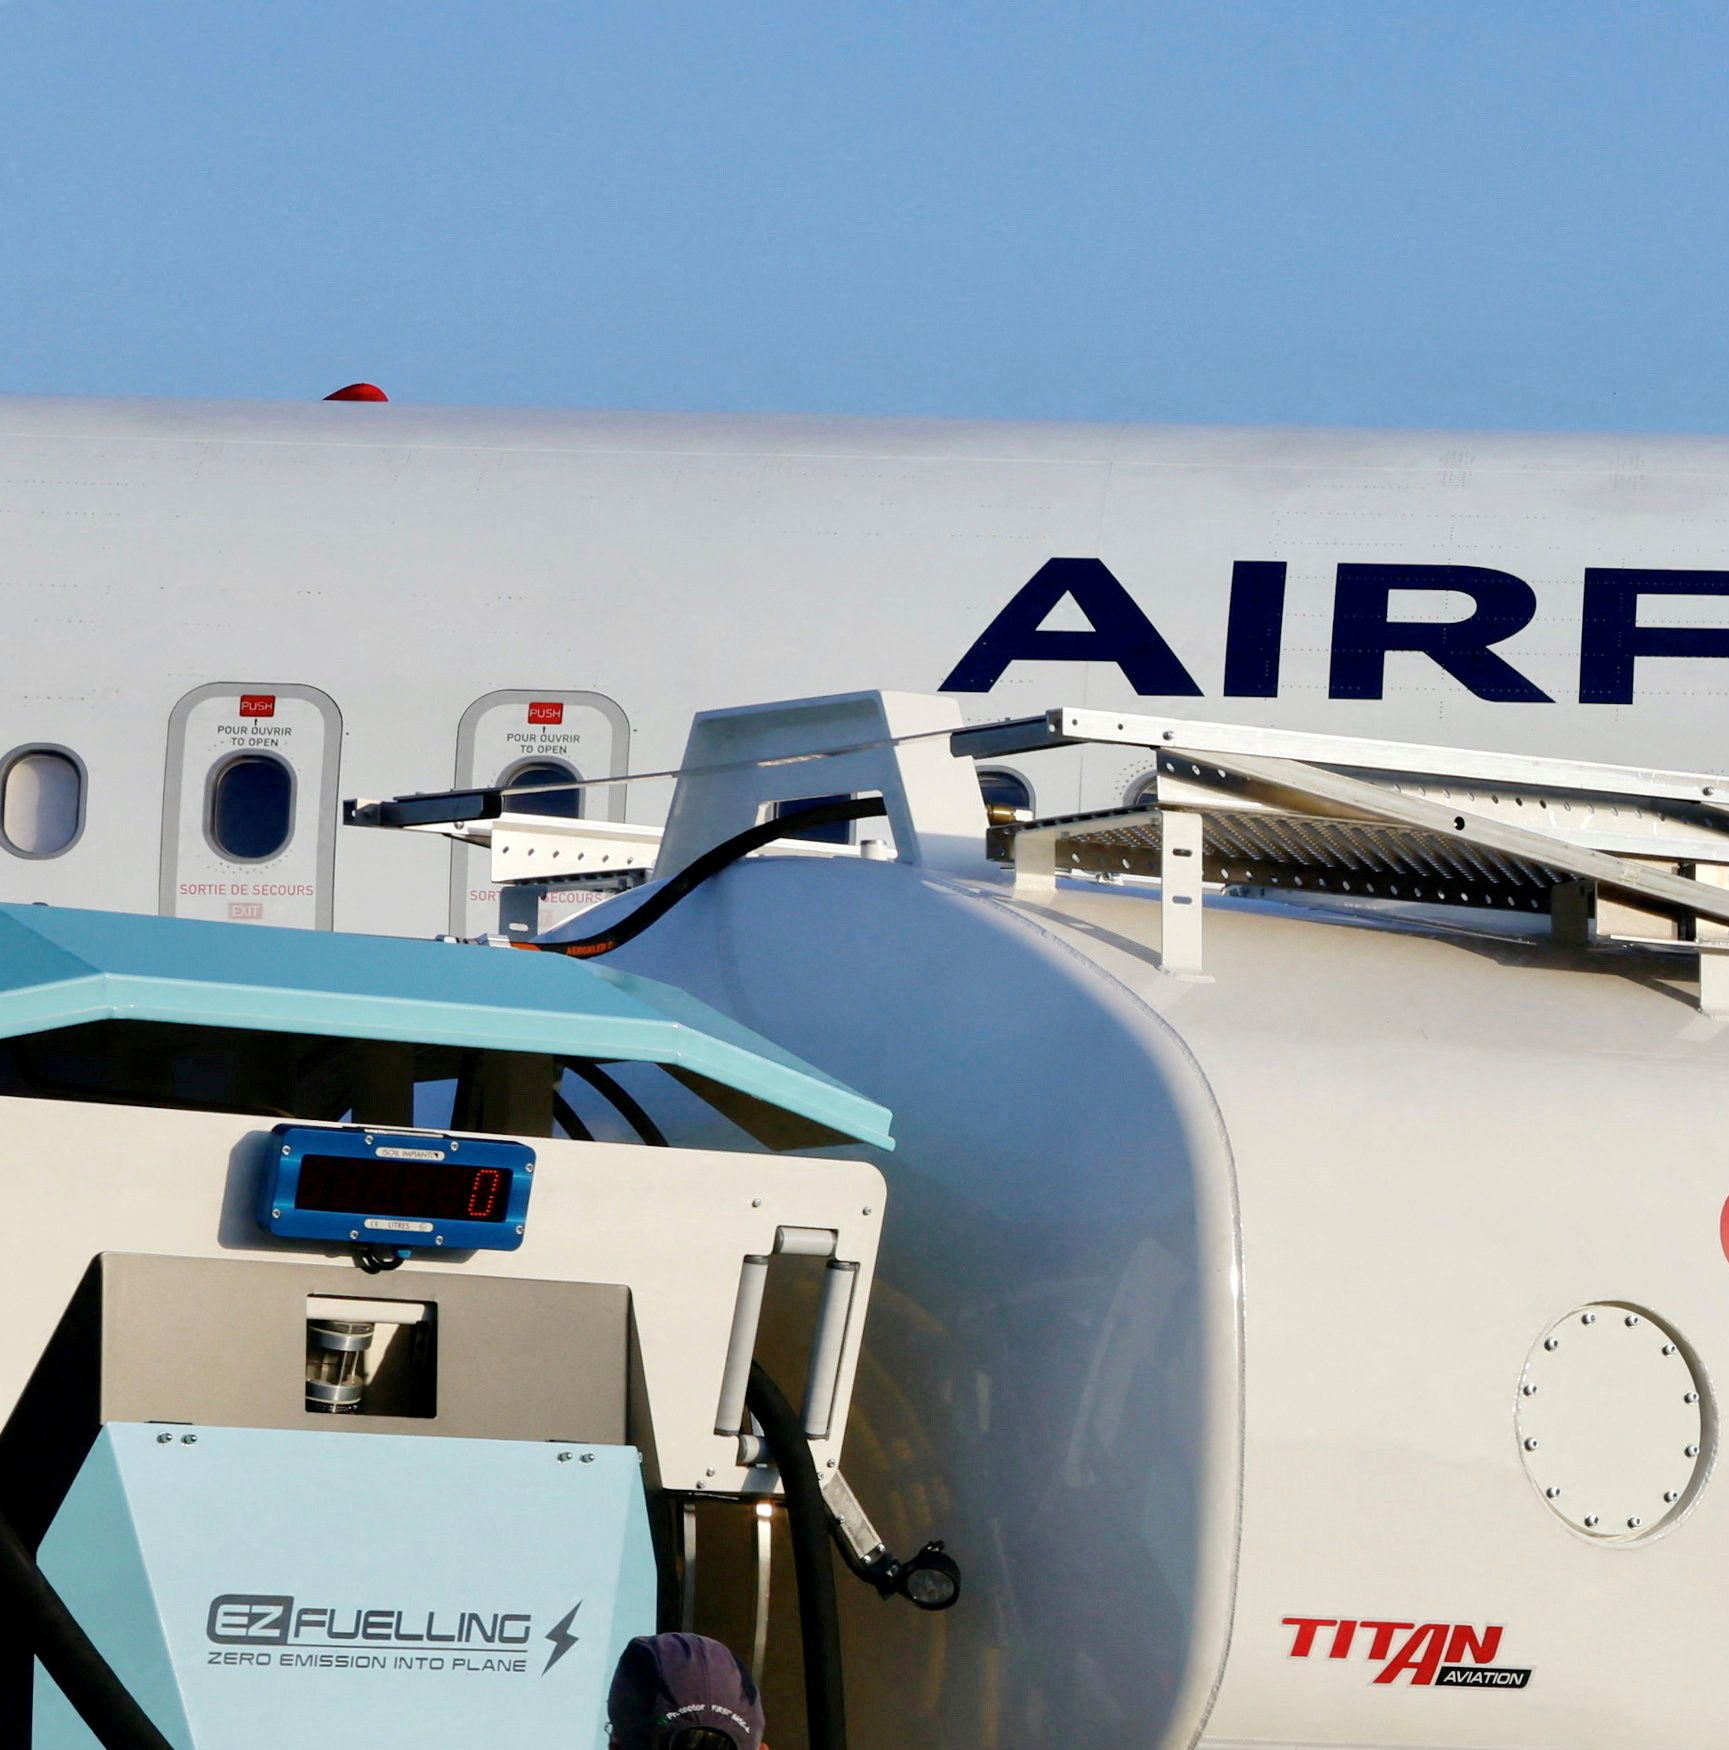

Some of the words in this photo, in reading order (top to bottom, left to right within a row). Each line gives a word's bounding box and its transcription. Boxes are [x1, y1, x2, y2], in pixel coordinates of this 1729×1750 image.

[241, 701, 274, 712] PUSH
[528, 708, 561, 718] PUSH
[217, 725, 248, 735] POUR
[251, 725, 292, 736] OUVRIR
[231, 737, 245, 746] TO
[249, 738, 279, 747] OPEN
[506, 733, 537, 743] POUR
[540, 734, 580, 744] OUVRIR
[520, 745, 534, 754] TO
[537, 745, 567, 754] OPEN
[180, 884, 226, 895] SORTIE
[231, 884, 247, 895] DE
[252, 884, 314, 896] SECOURS
[232, 905, 259, 917] EXIT
[468, 1169, 499, 1216] 0
[1281, 1615, 1503, 1687] TITAN
[207, 1652, 271, 1666] ZERO
[279, 1653, 387, 1669] EMISSION
[394, 1656, 445, 1671] INTO
[452, 1658, 527, 1673] PLANE
[1441, 1669, 1524, 1687] AVIATION
